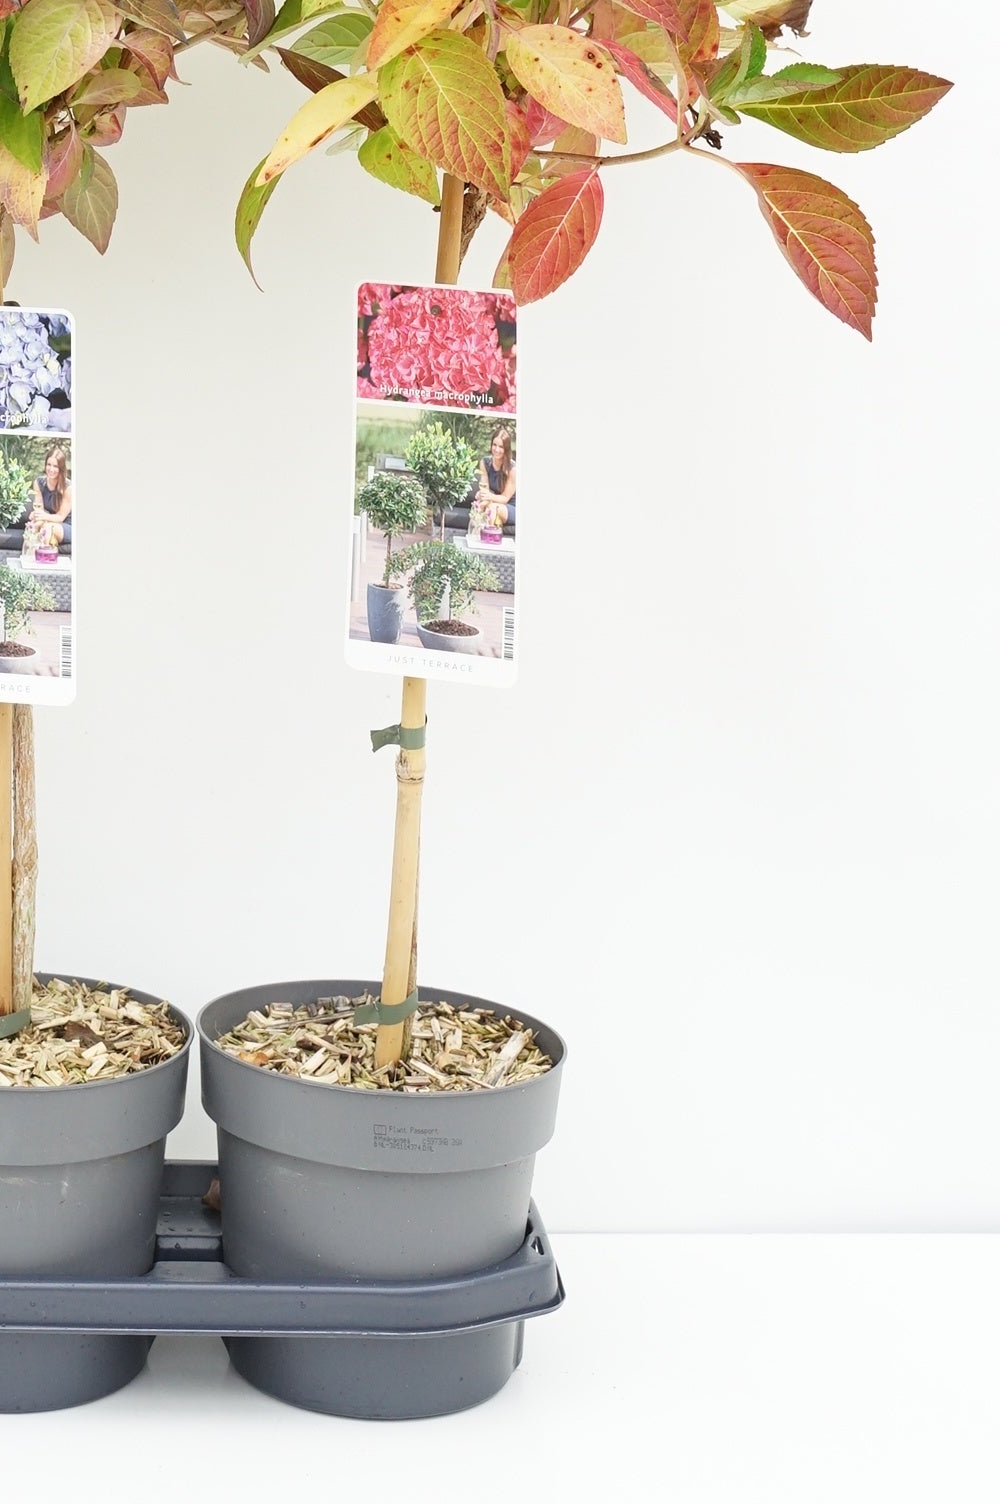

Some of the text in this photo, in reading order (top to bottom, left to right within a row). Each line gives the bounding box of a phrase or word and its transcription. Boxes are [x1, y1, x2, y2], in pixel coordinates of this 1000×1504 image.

[379, 383, 494, 405] Hydrangea macrophylla
[387, 655, 473, 673] JUST TERRACE
[409, 1126, 439, 1135] Passport
